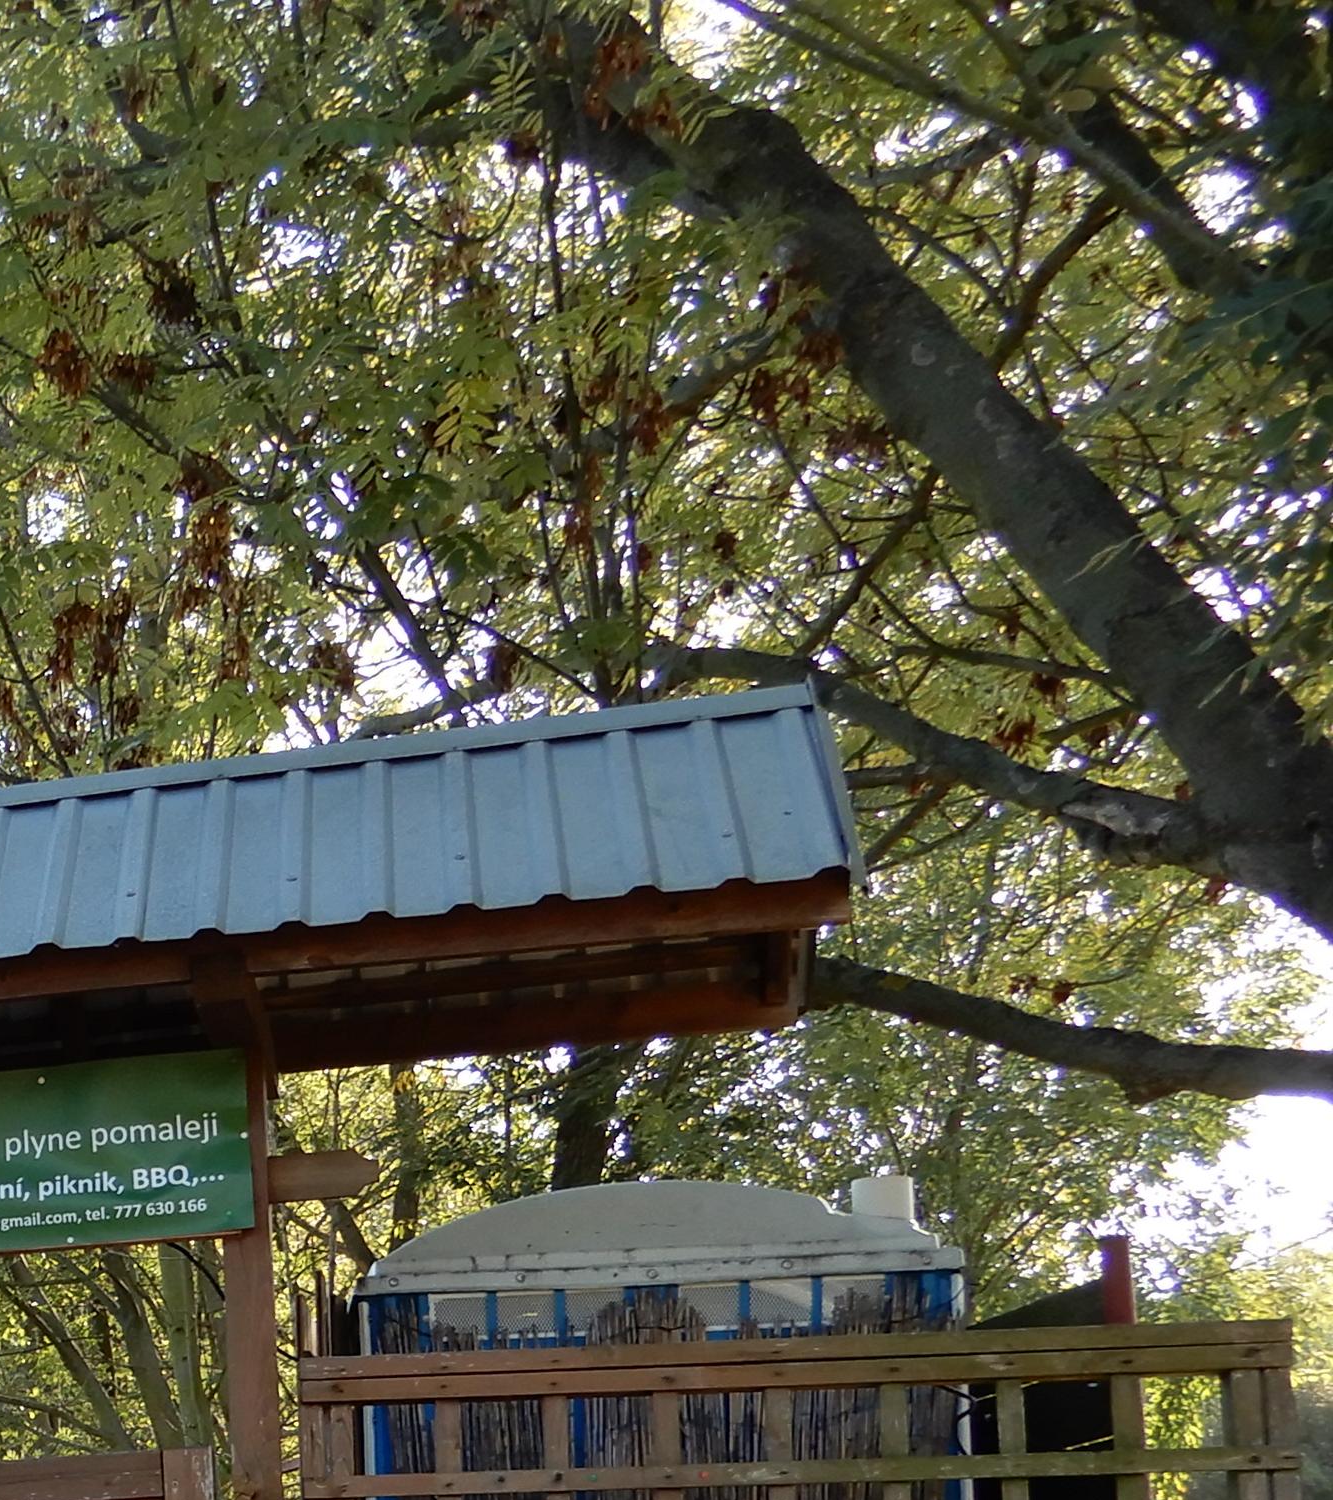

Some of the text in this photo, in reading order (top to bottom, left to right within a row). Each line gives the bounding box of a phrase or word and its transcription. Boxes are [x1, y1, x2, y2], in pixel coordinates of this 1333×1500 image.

[5, 1129, 82, 1161] plyne
[91, 1112, 218, 1152] pomaleji
[38, 1170, 125, 1201] piknik,
[85, 1206, 110, 1221] tel.
[114, 1204, 142, 1219] 777
[146, 1201, 175, 1216] 630
[179, 1198, 207, 1214] 166
